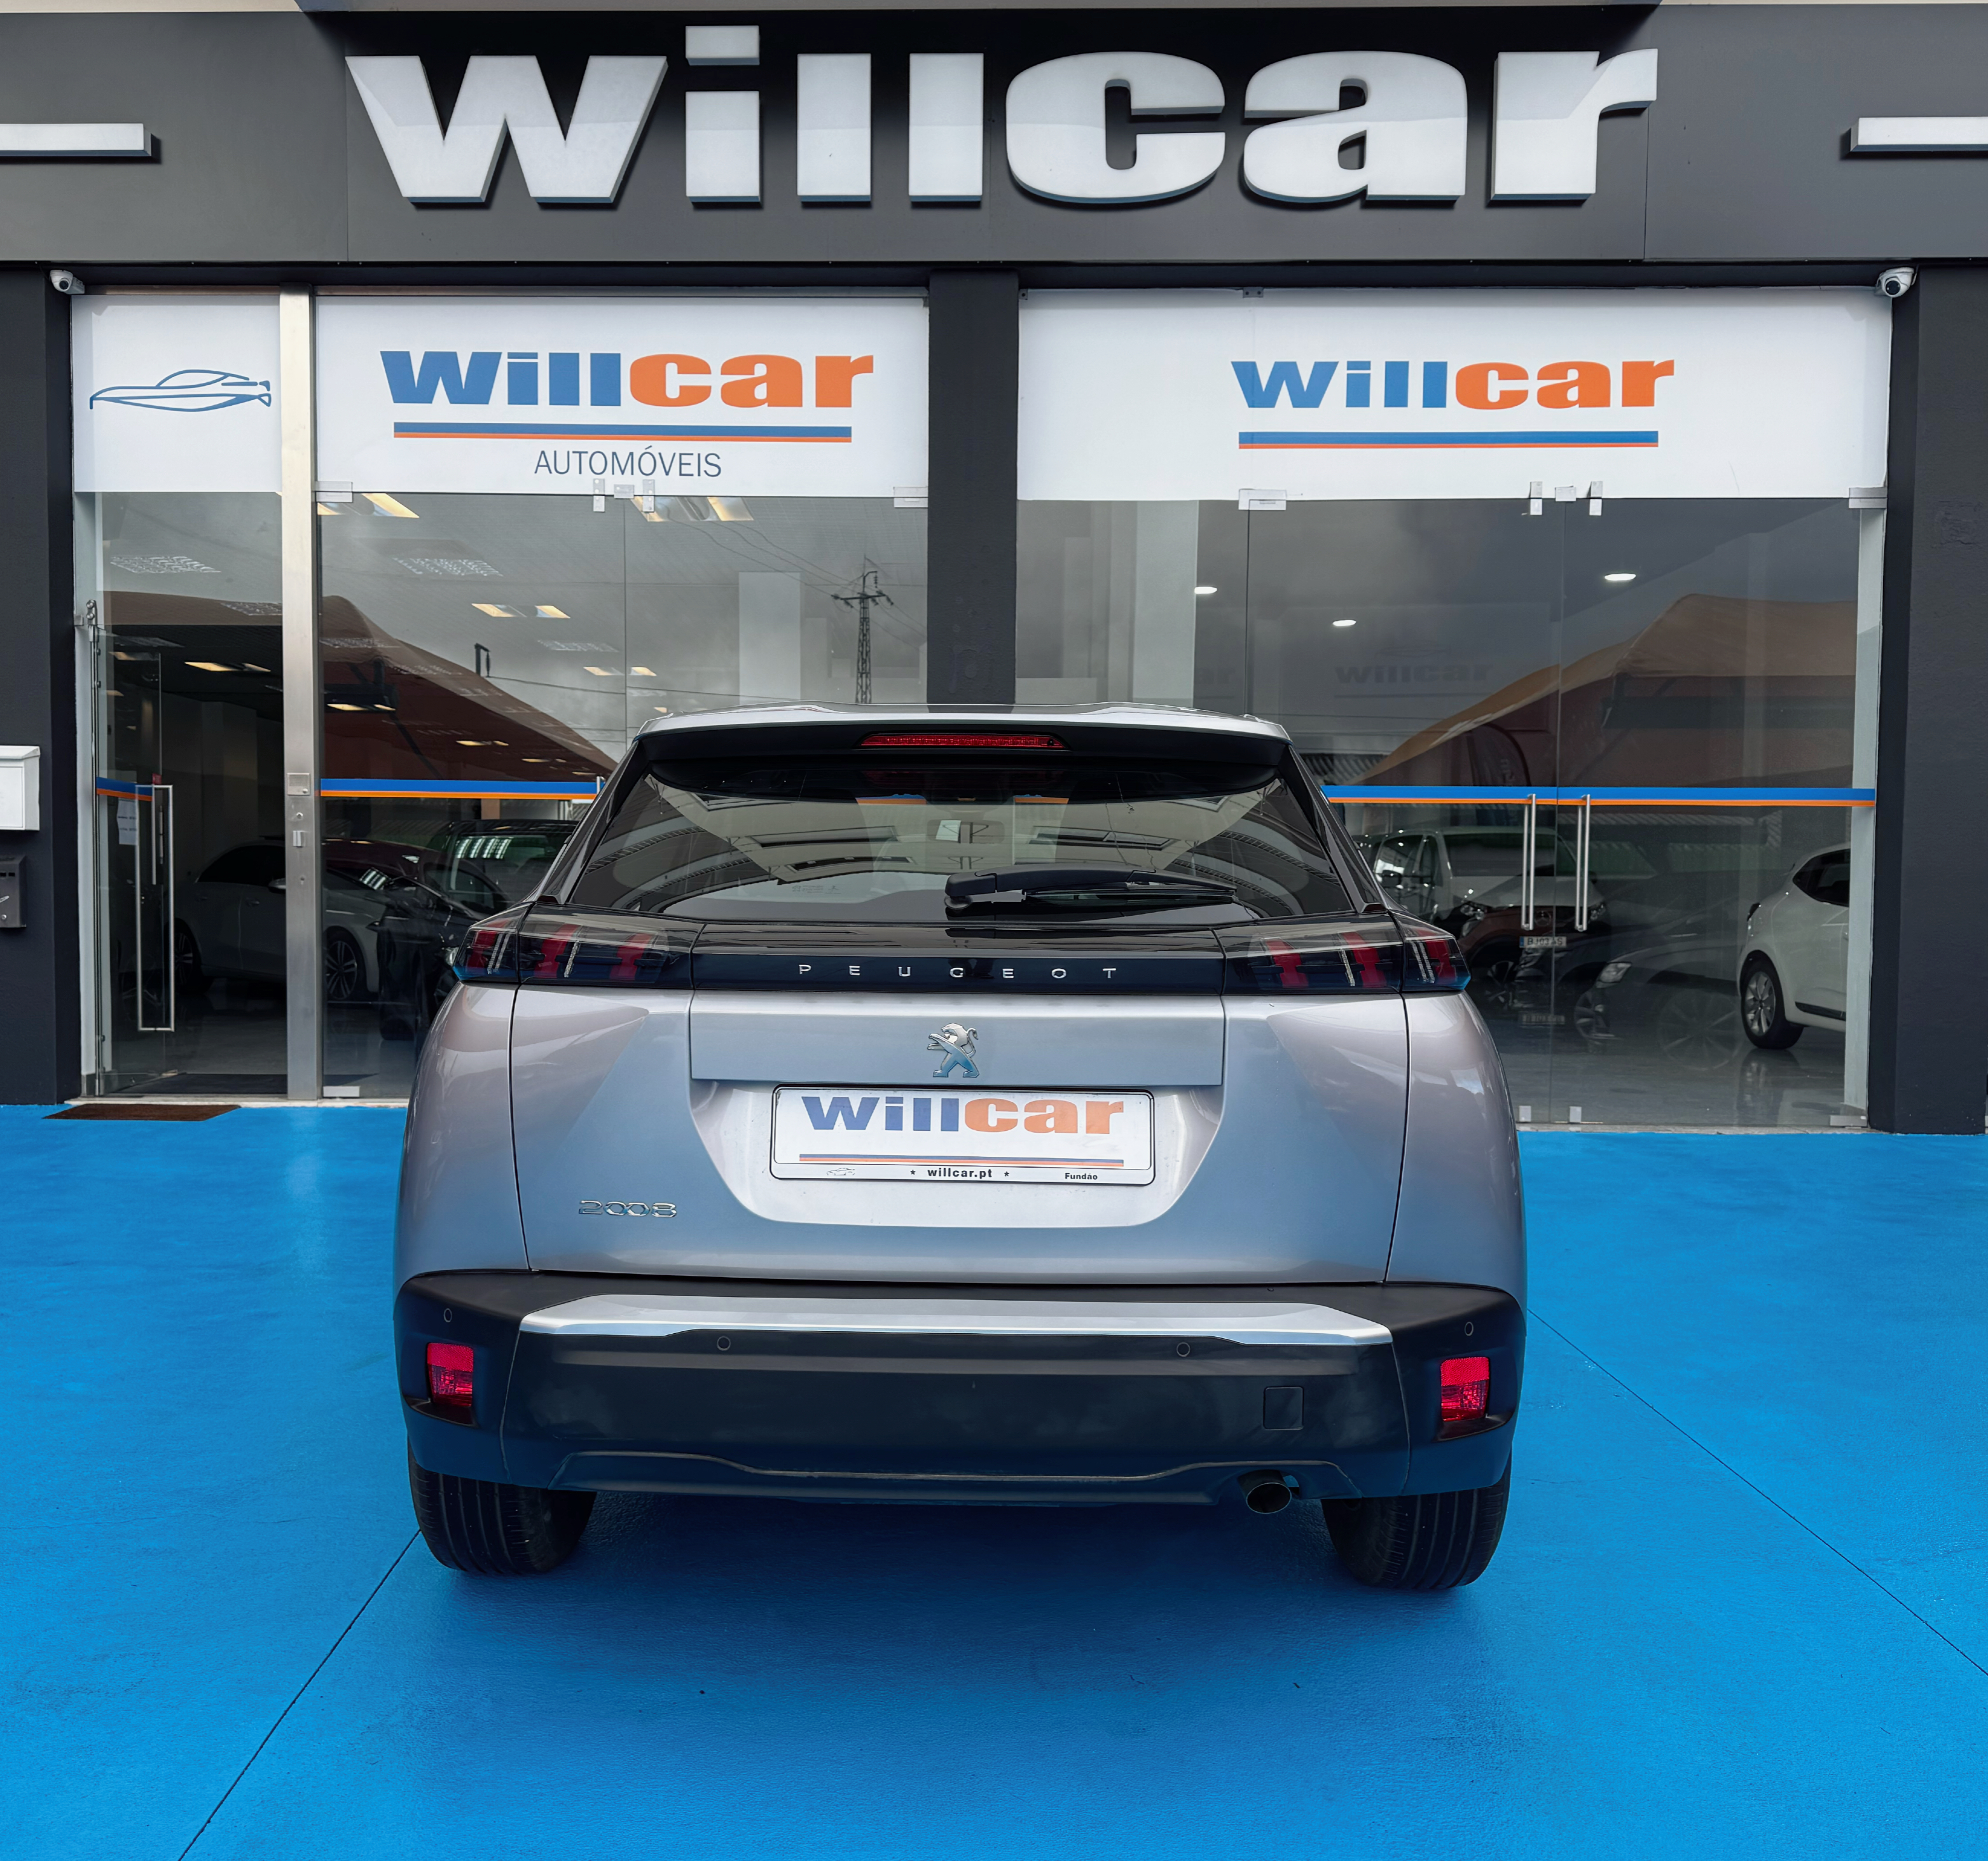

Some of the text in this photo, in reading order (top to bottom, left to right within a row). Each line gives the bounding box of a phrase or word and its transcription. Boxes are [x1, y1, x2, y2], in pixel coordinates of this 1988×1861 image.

[345, 25, 1658, 204] willcar
[380, 350, 874, 408] willcar
[1231, 359, 1674, 410] willcar
[534, 445, 722, 478] AUTOMÓVEIS
[798, 964, 1117, 979] PEUGEOT
[801, 1097, 1124, 1134] willcar
[927, 1167, 992, 1179] willcar.pt
[579, 1200, 677, 1218] 2008
